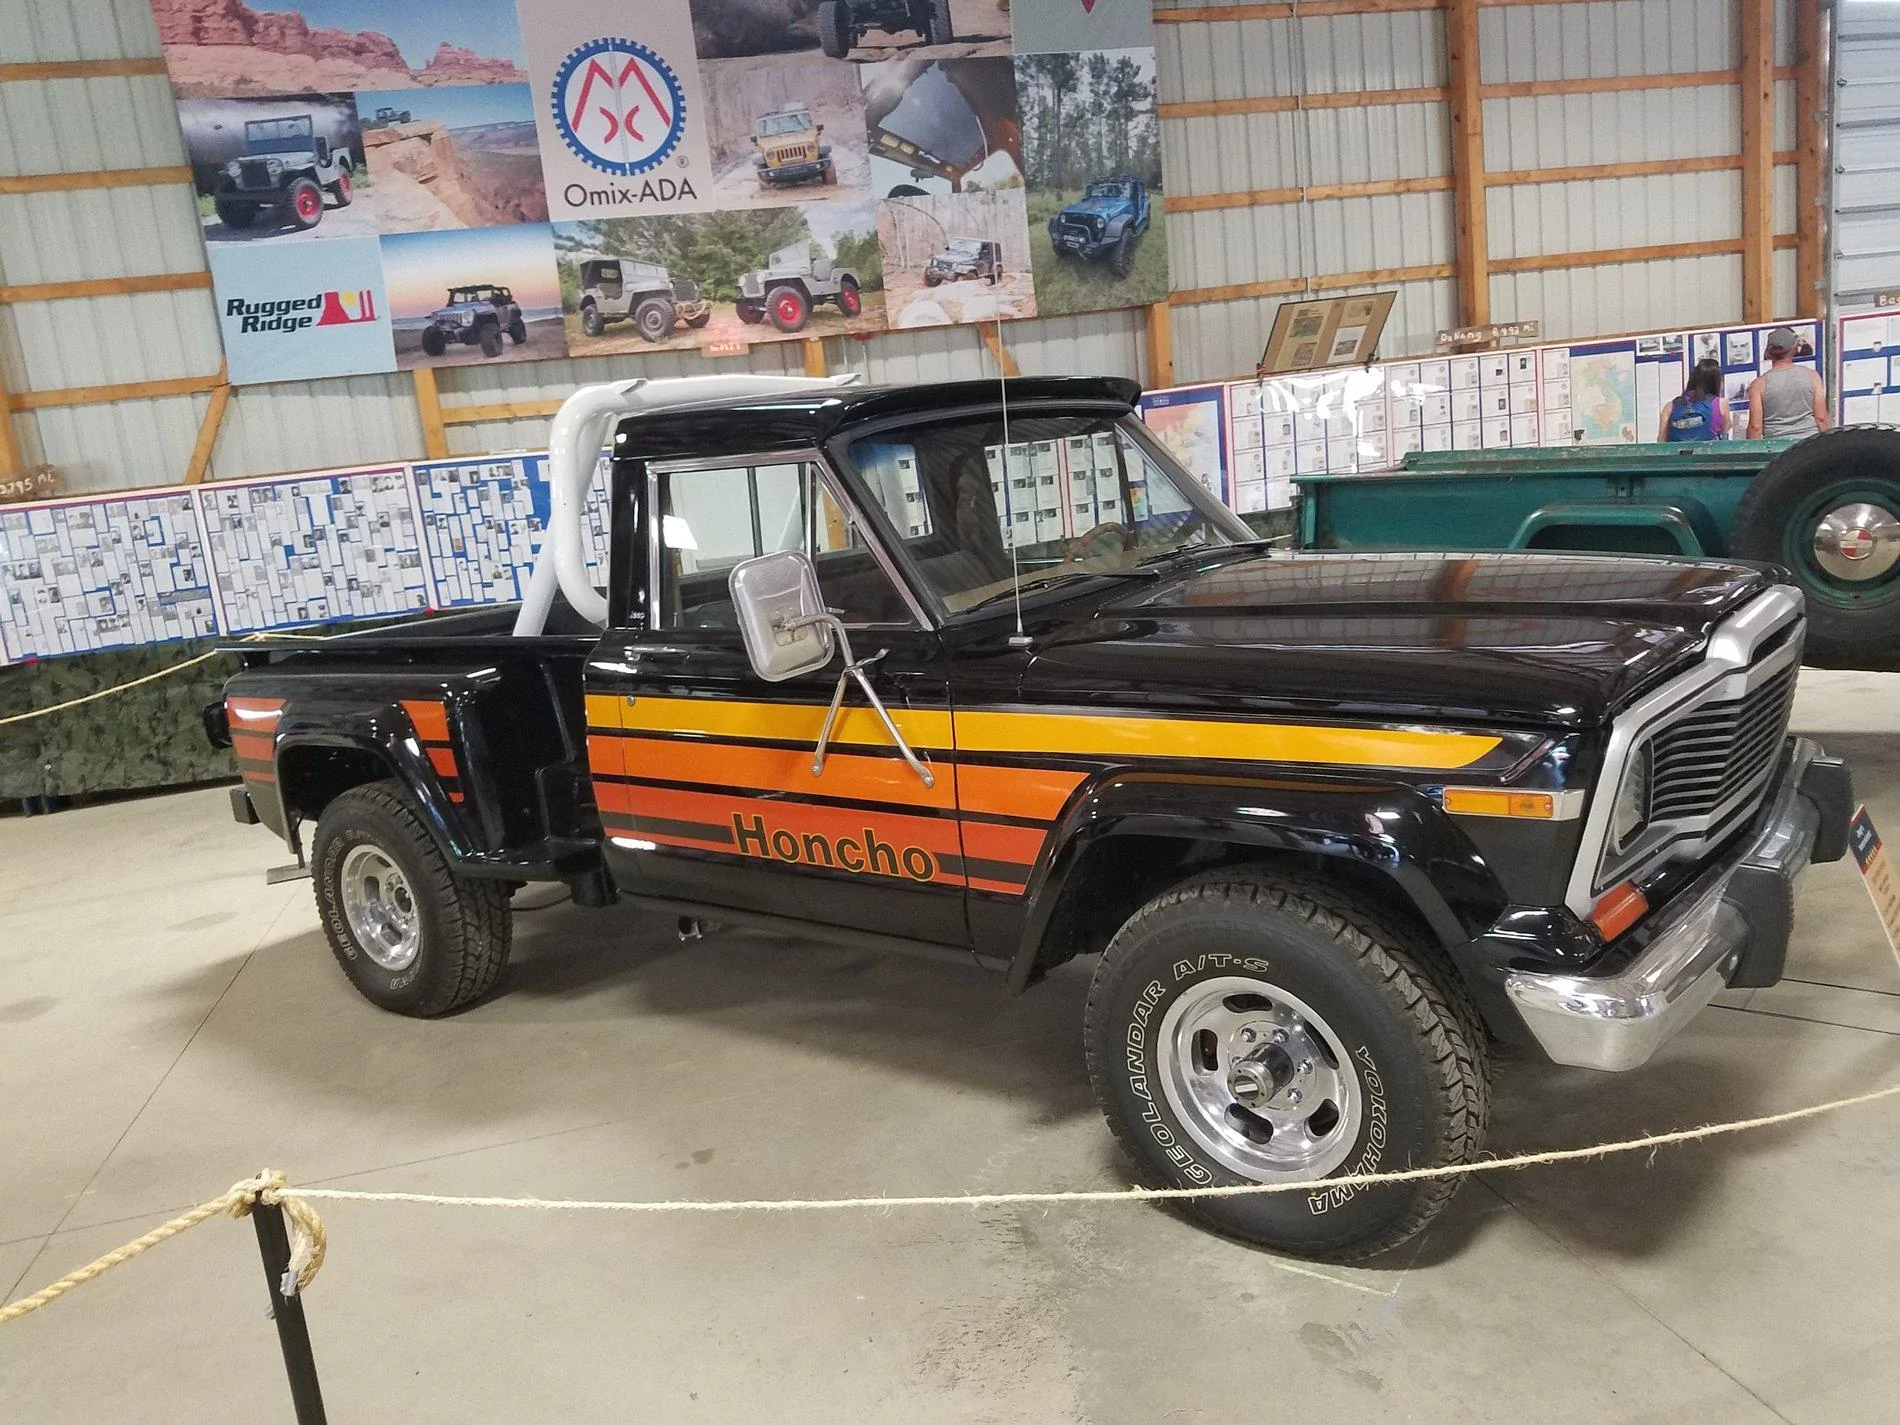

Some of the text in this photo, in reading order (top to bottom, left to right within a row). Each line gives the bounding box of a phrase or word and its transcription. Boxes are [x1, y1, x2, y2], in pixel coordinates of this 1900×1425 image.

[564, 177, 697, 207] Omix-ADA
[226, 294, 322, 316] Rugged
[241, 316, 312, 333] Ridge
[731, 811, 936, 883] Honcho
[1127, 980, 1213, 1185] GEOLANDAR
